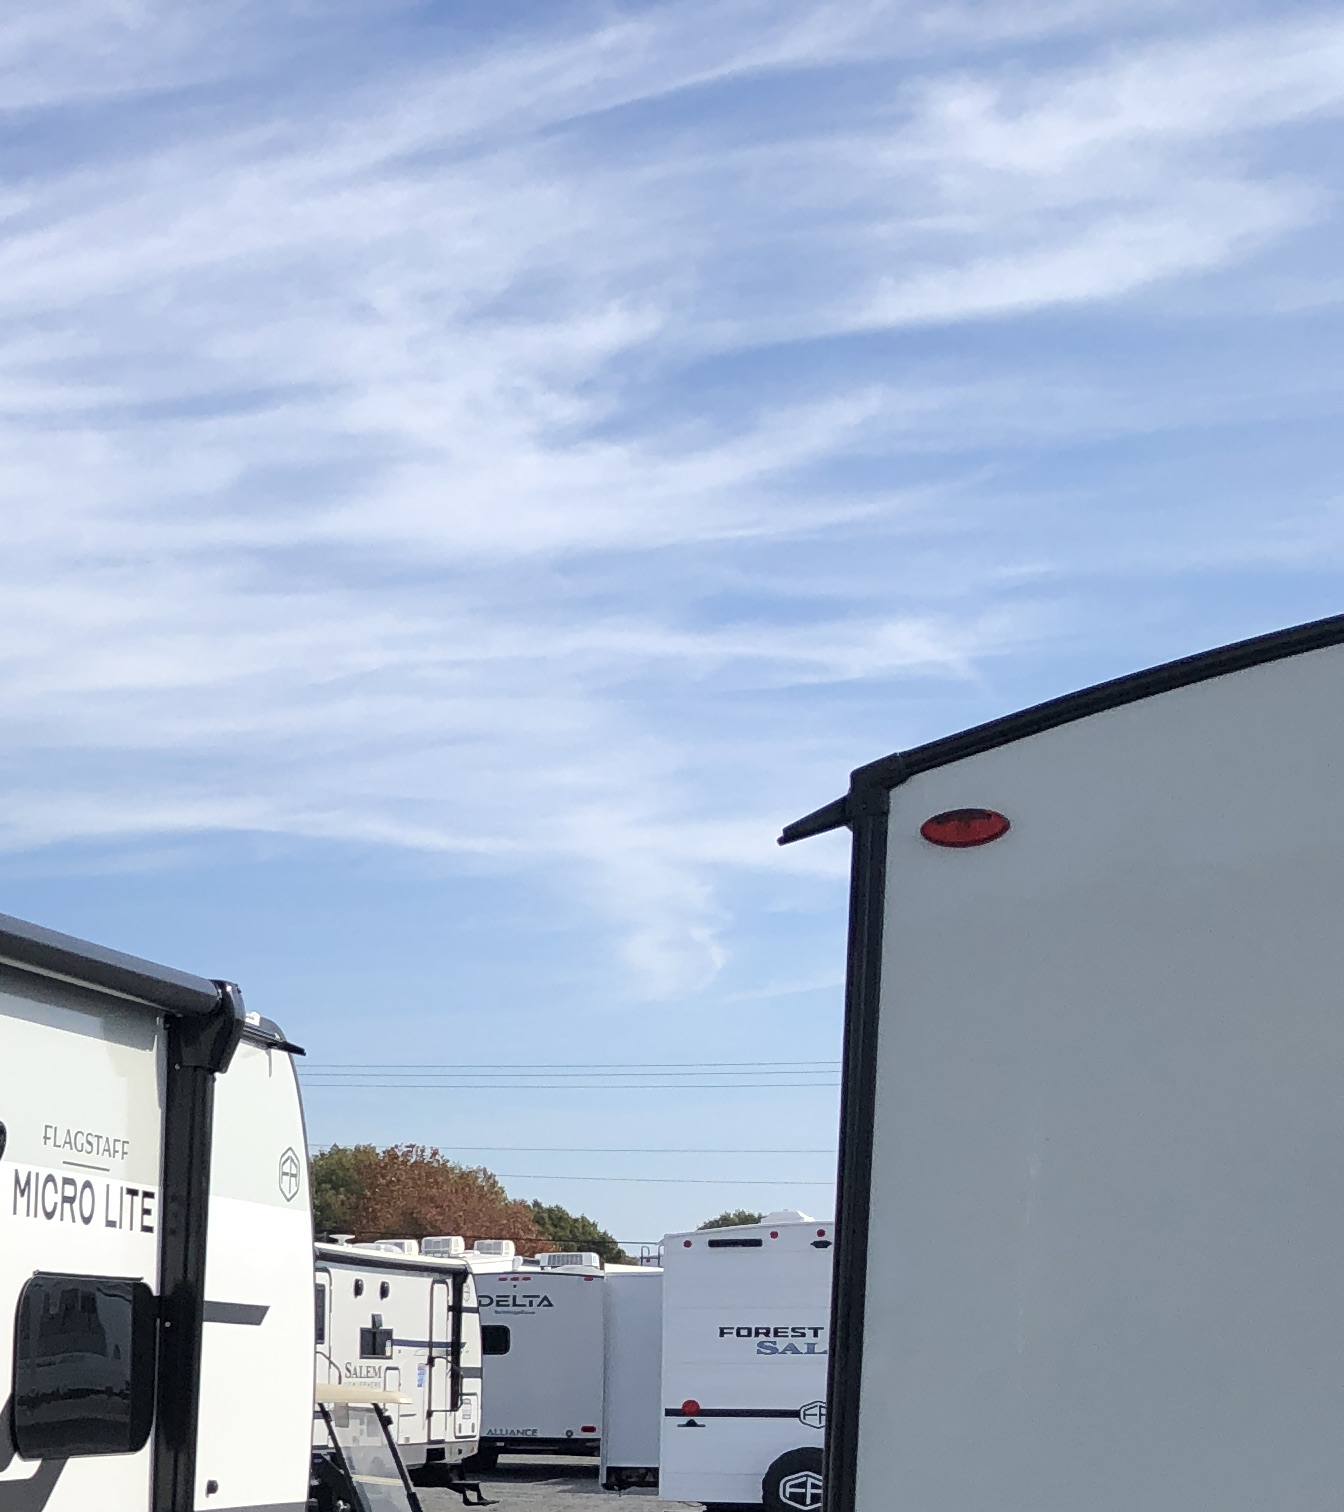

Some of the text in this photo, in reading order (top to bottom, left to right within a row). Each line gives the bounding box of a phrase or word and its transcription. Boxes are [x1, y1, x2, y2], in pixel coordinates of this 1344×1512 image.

[42, 1123, 130, 1161] FLAGSTAFF
[12, 1168, 156, 1234] MICRO LITE
[477, 1294, 555, 1308] DELTA
[718, 1326, 825, 1339] FOREST
[756, 1340, 829, 1356] SAL
[344, 1361, 383, 1379] SALEM
[486, 1428, 539, 1437] ALLIANCE
